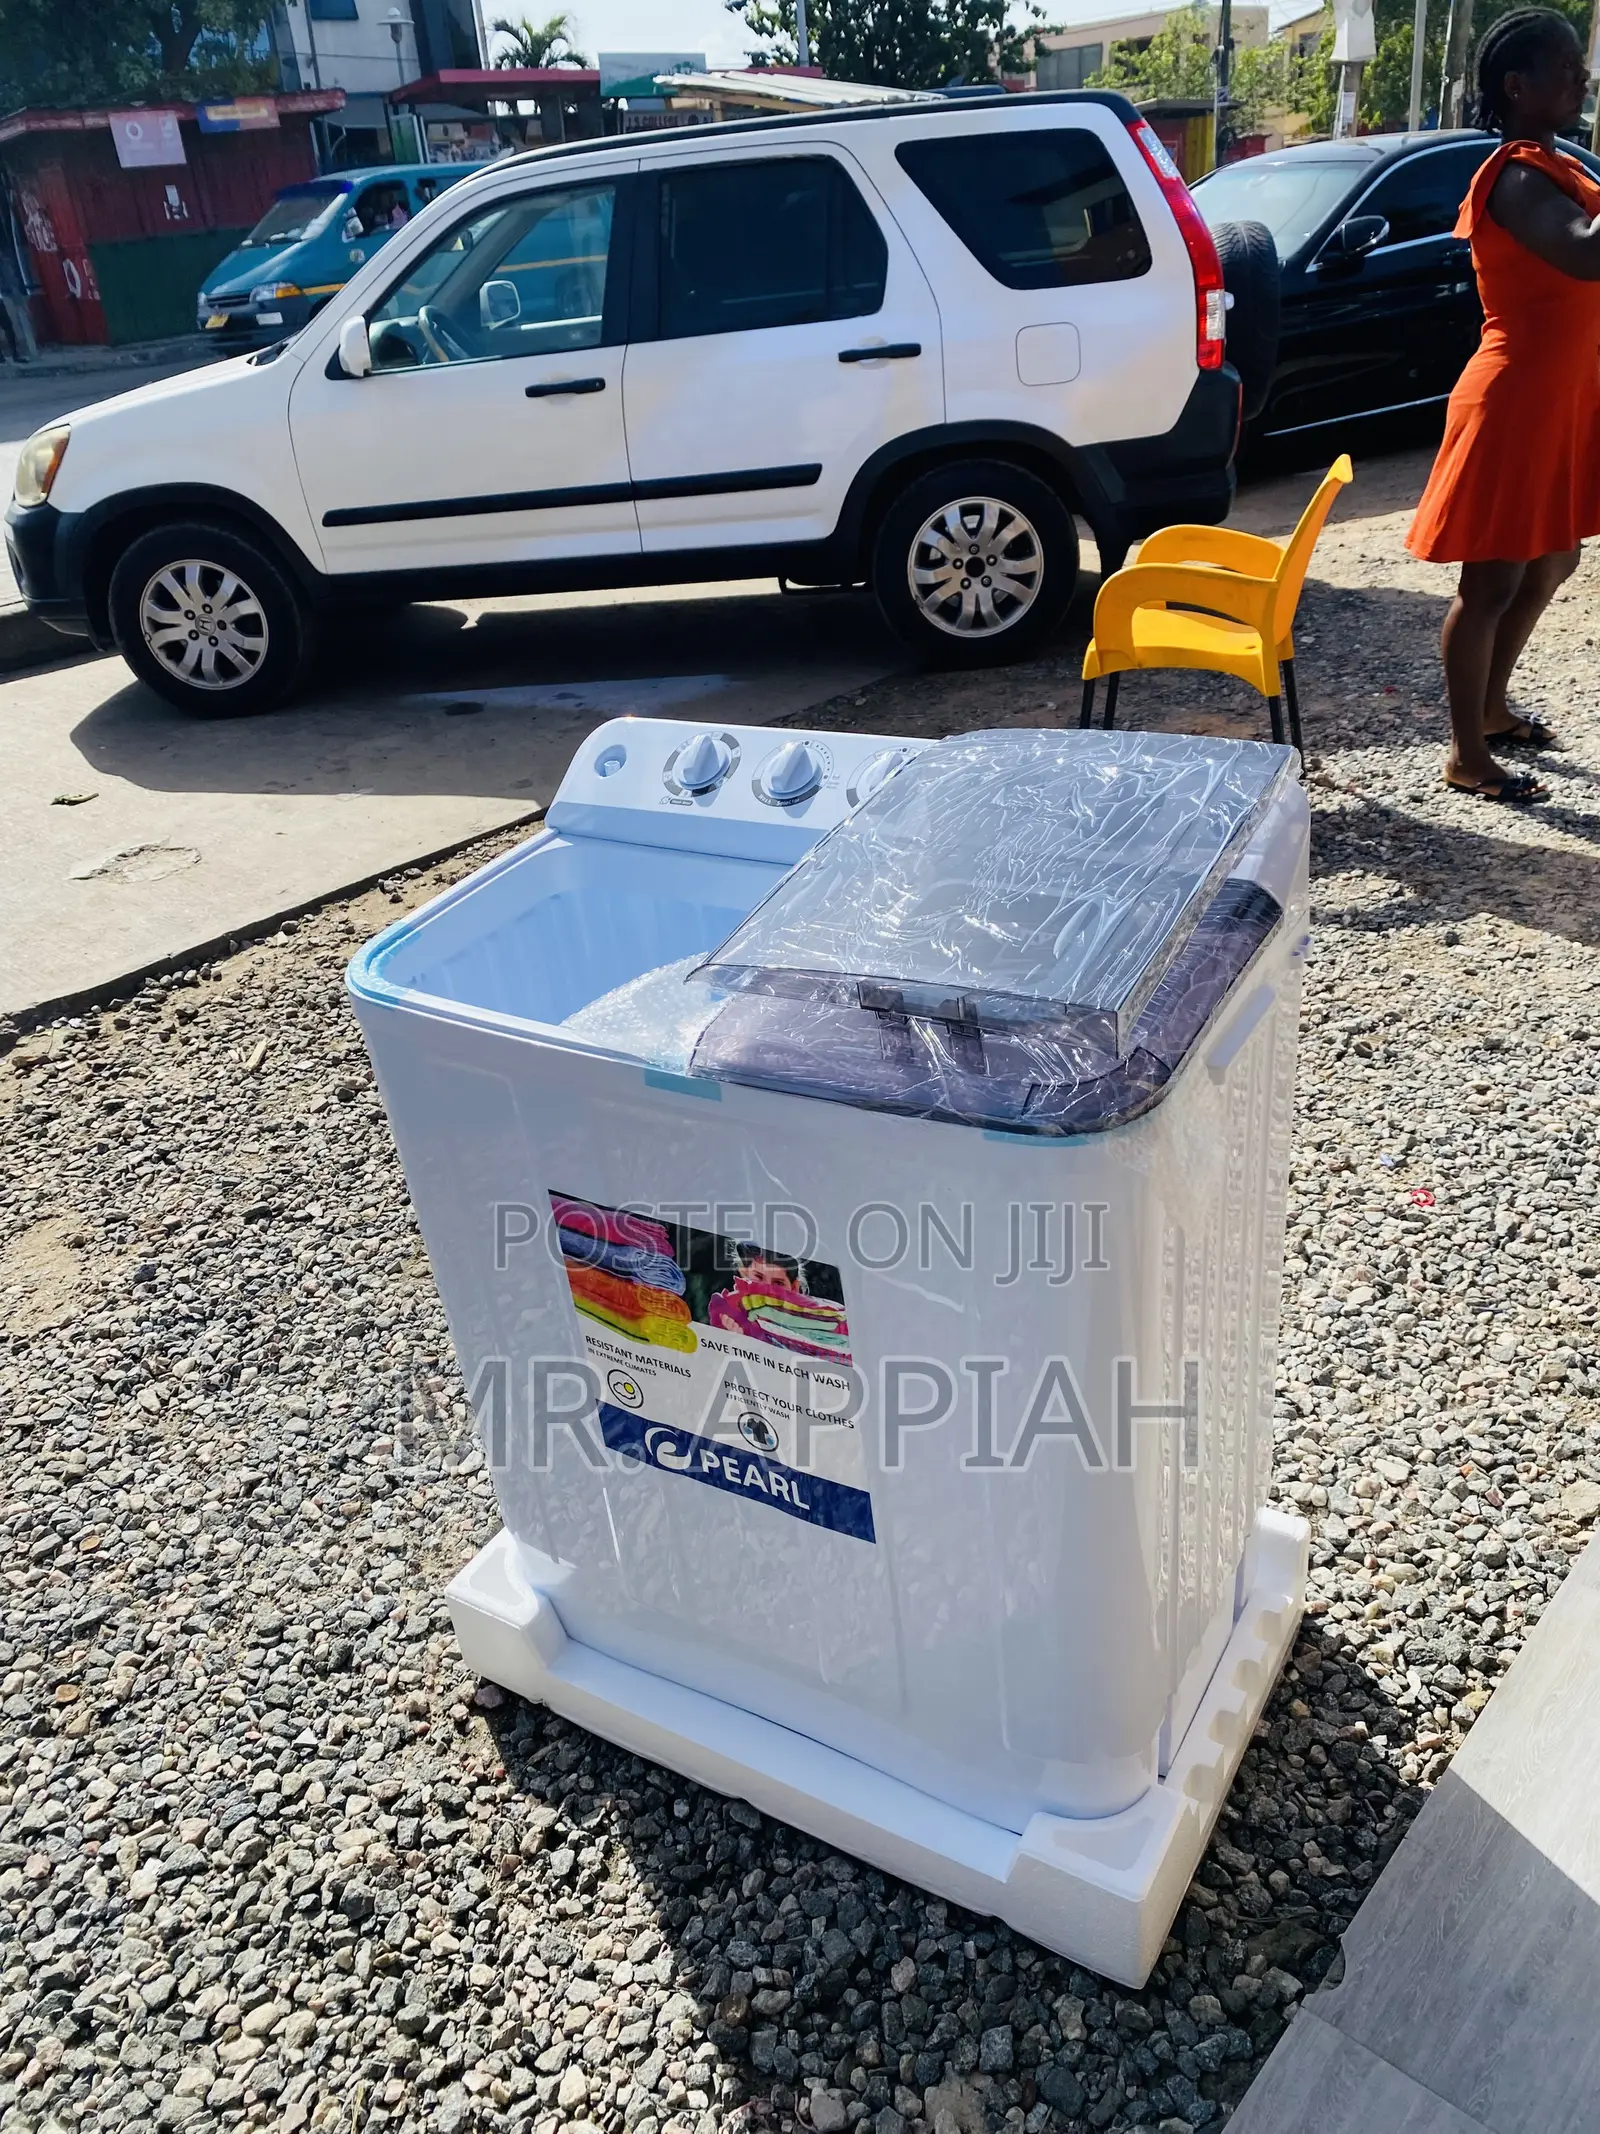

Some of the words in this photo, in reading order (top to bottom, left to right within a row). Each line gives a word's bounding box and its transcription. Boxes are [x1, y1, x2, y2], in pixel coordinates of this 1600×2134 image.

[585, 1335, 634, 1361] RESISTANT
[635, 1354, 692, 1378] MATERIALS
[596, 1350, 624, 1366] EXTREME
[624, 1361, 657, 1376] CLIMATES
[700, 1338, 730, 1354] SAVE
[731, 1346, 761, 1364] TIME
[763, 1356, 776, 1369] IN
[778, 1362, 810, 1380] EACH
[812, 1371, 851, 1392] WASH
[724, 1380, 770, 1402] PROTECT
[771, 1396, 803, 1415] YOUR
[805, 1408, 855, 1429] CLOTHES
[726, 1392, 768, 1411] EFFICIENTLY
[768, 1406, 791, 1420] WASH
[700, 1448, 810, 1510] PEARL
